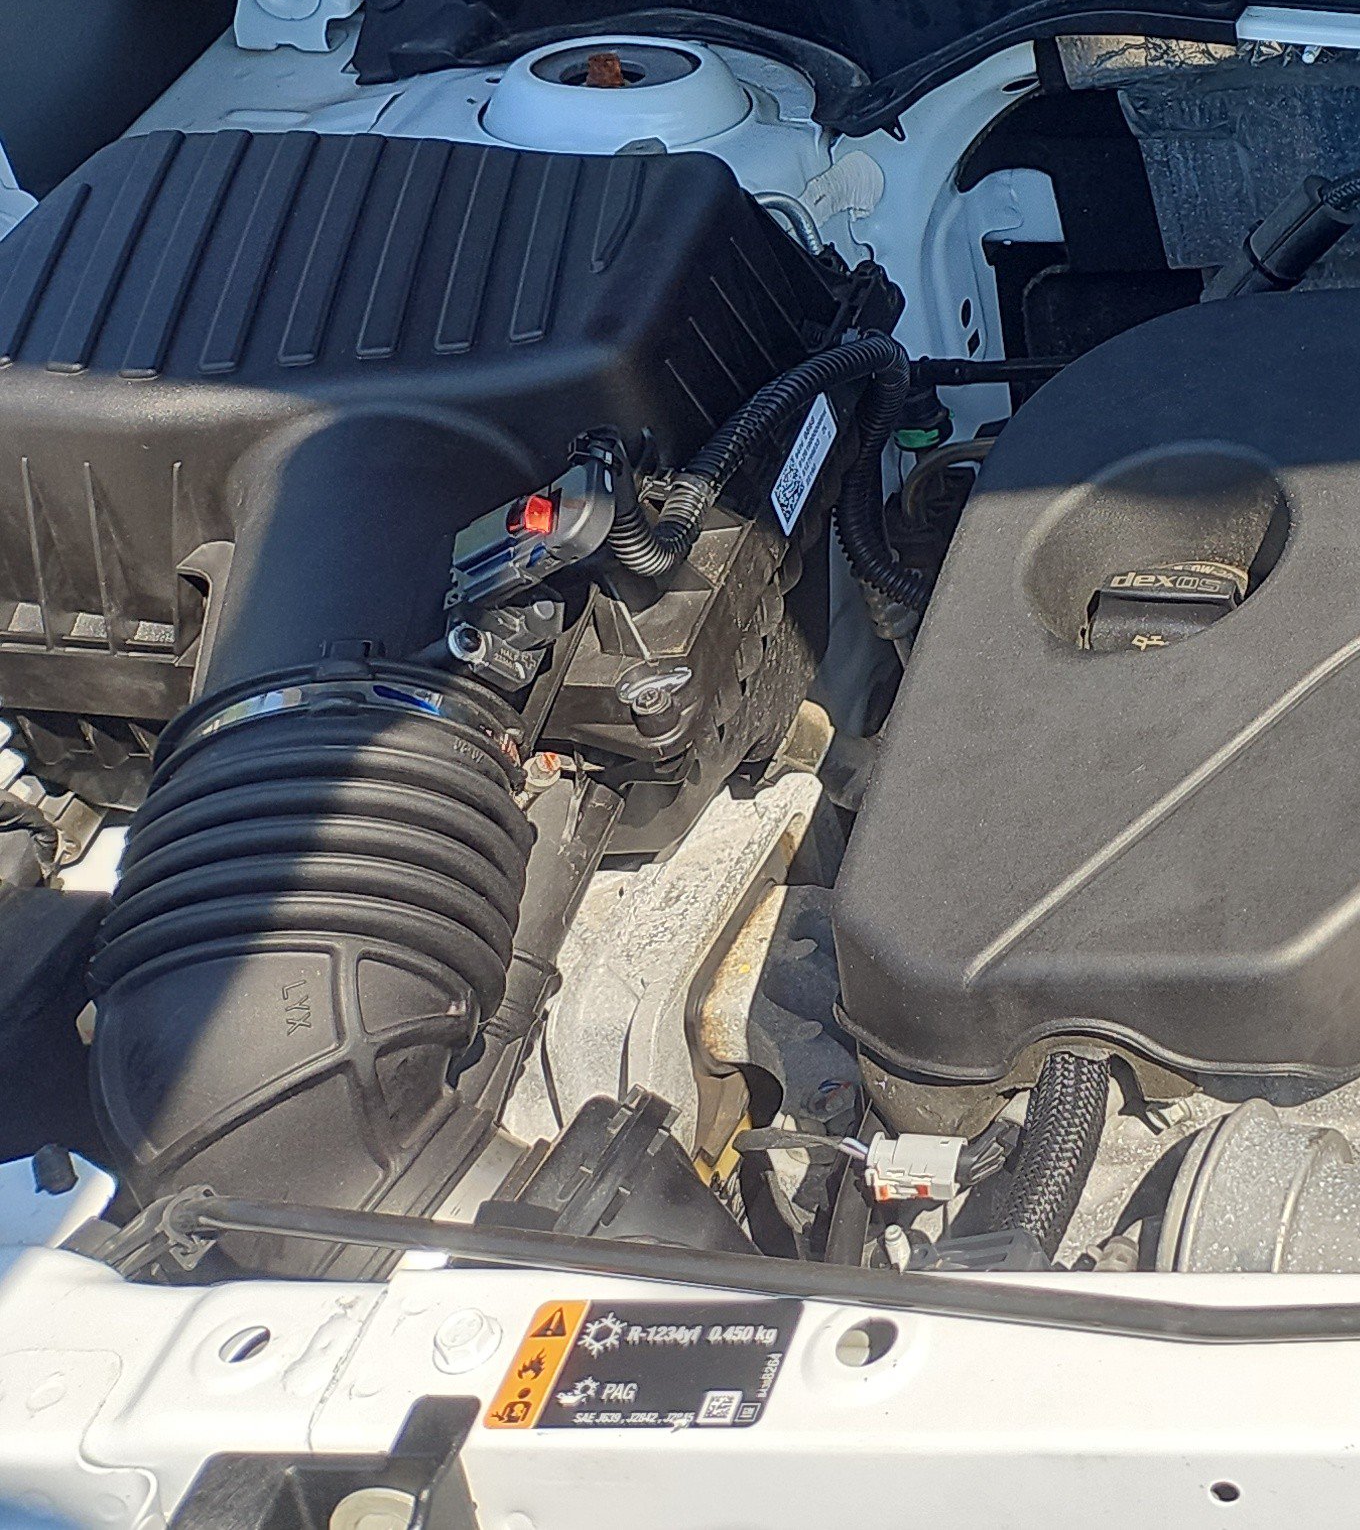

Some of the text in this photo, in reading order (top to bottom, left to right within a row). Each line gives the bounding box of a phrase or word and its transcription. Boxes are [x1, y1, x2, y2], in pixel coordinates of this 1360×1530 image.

[282, 979, 311, 1036] LYX
[626, 1325, 778, 1346] R-1234yf 0.450 kg
[602, 1383, 638, 1401] PAG
[572, 1412, 594, 1424] SAE
